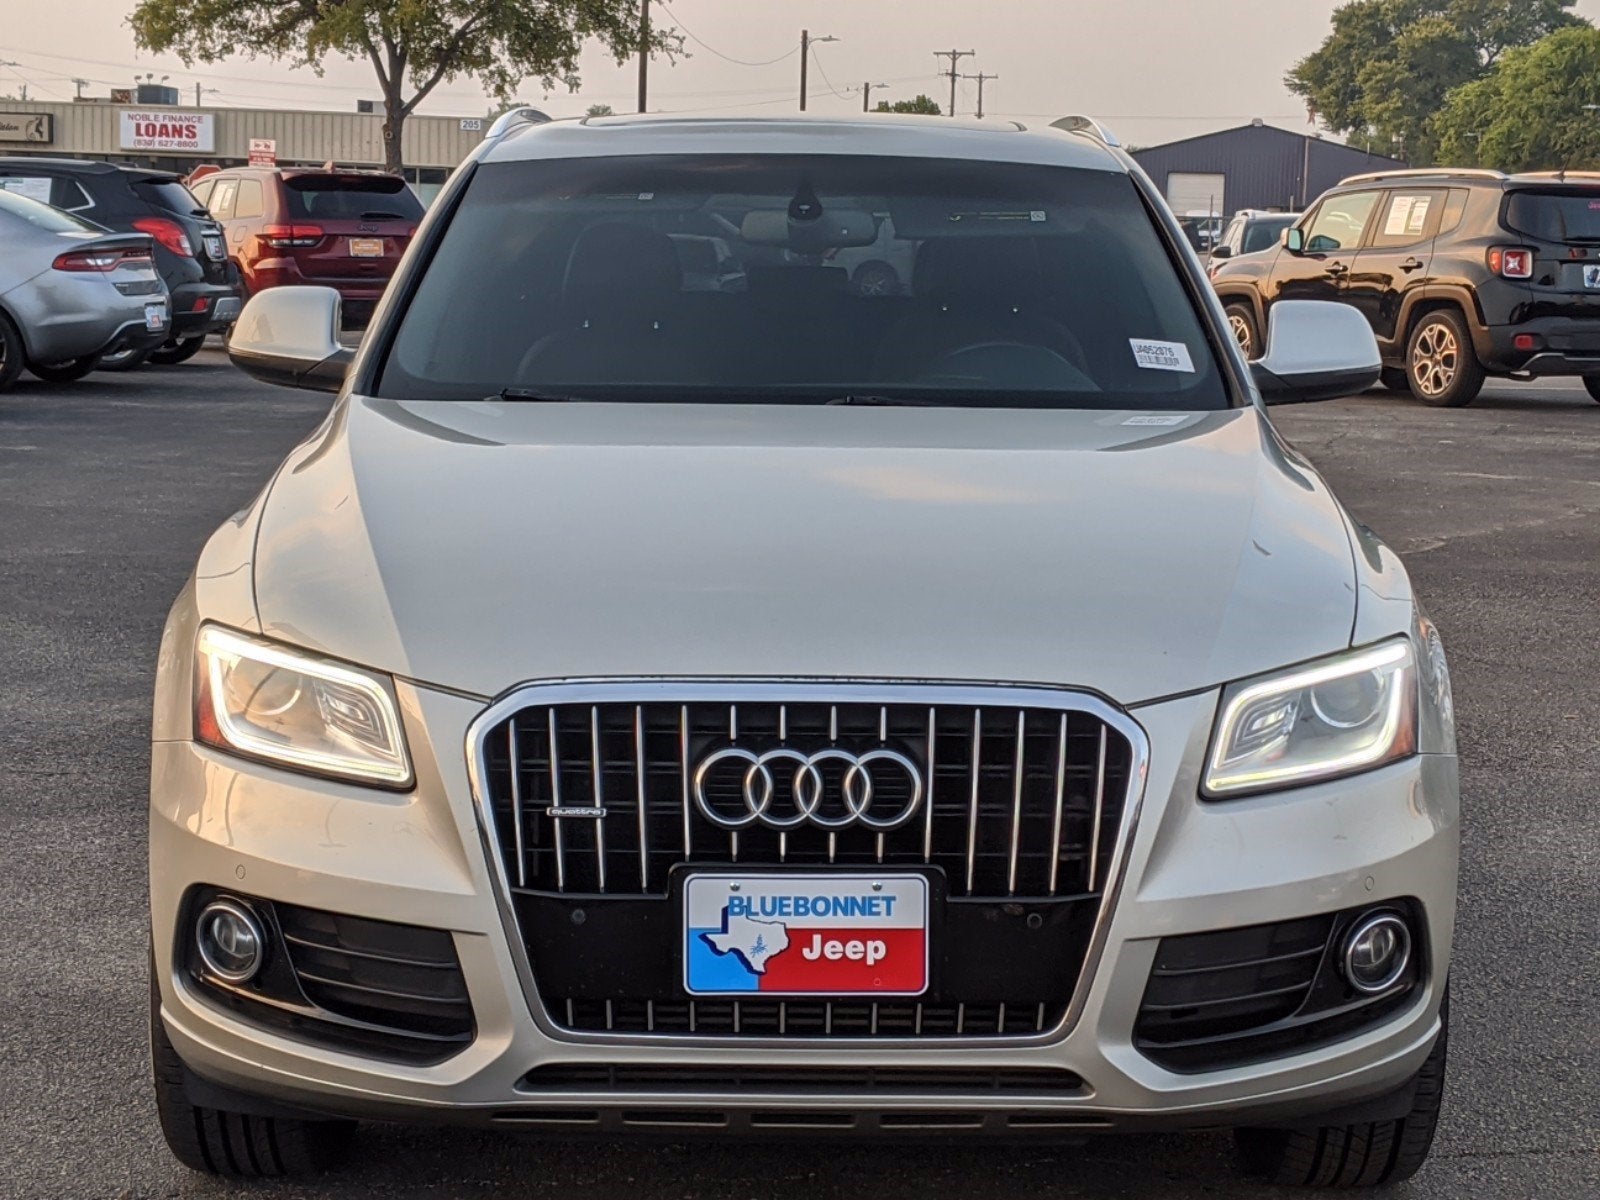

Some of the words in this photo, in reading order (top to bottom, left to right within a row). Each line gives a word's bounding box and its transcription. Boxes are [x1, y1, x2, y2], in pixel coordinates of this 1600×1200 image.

[128, 113, 160, 122] NOBLE
[163, 114, 204, 124] FINANCE
[462, 120, 480, 129] 205
[135, 122, 197, 139] LOANS
[551, 808, 602, 817] quattro
[727, 895, 897, 918] BLUEBONNET
[801, 934, 887, 966] Jeep
